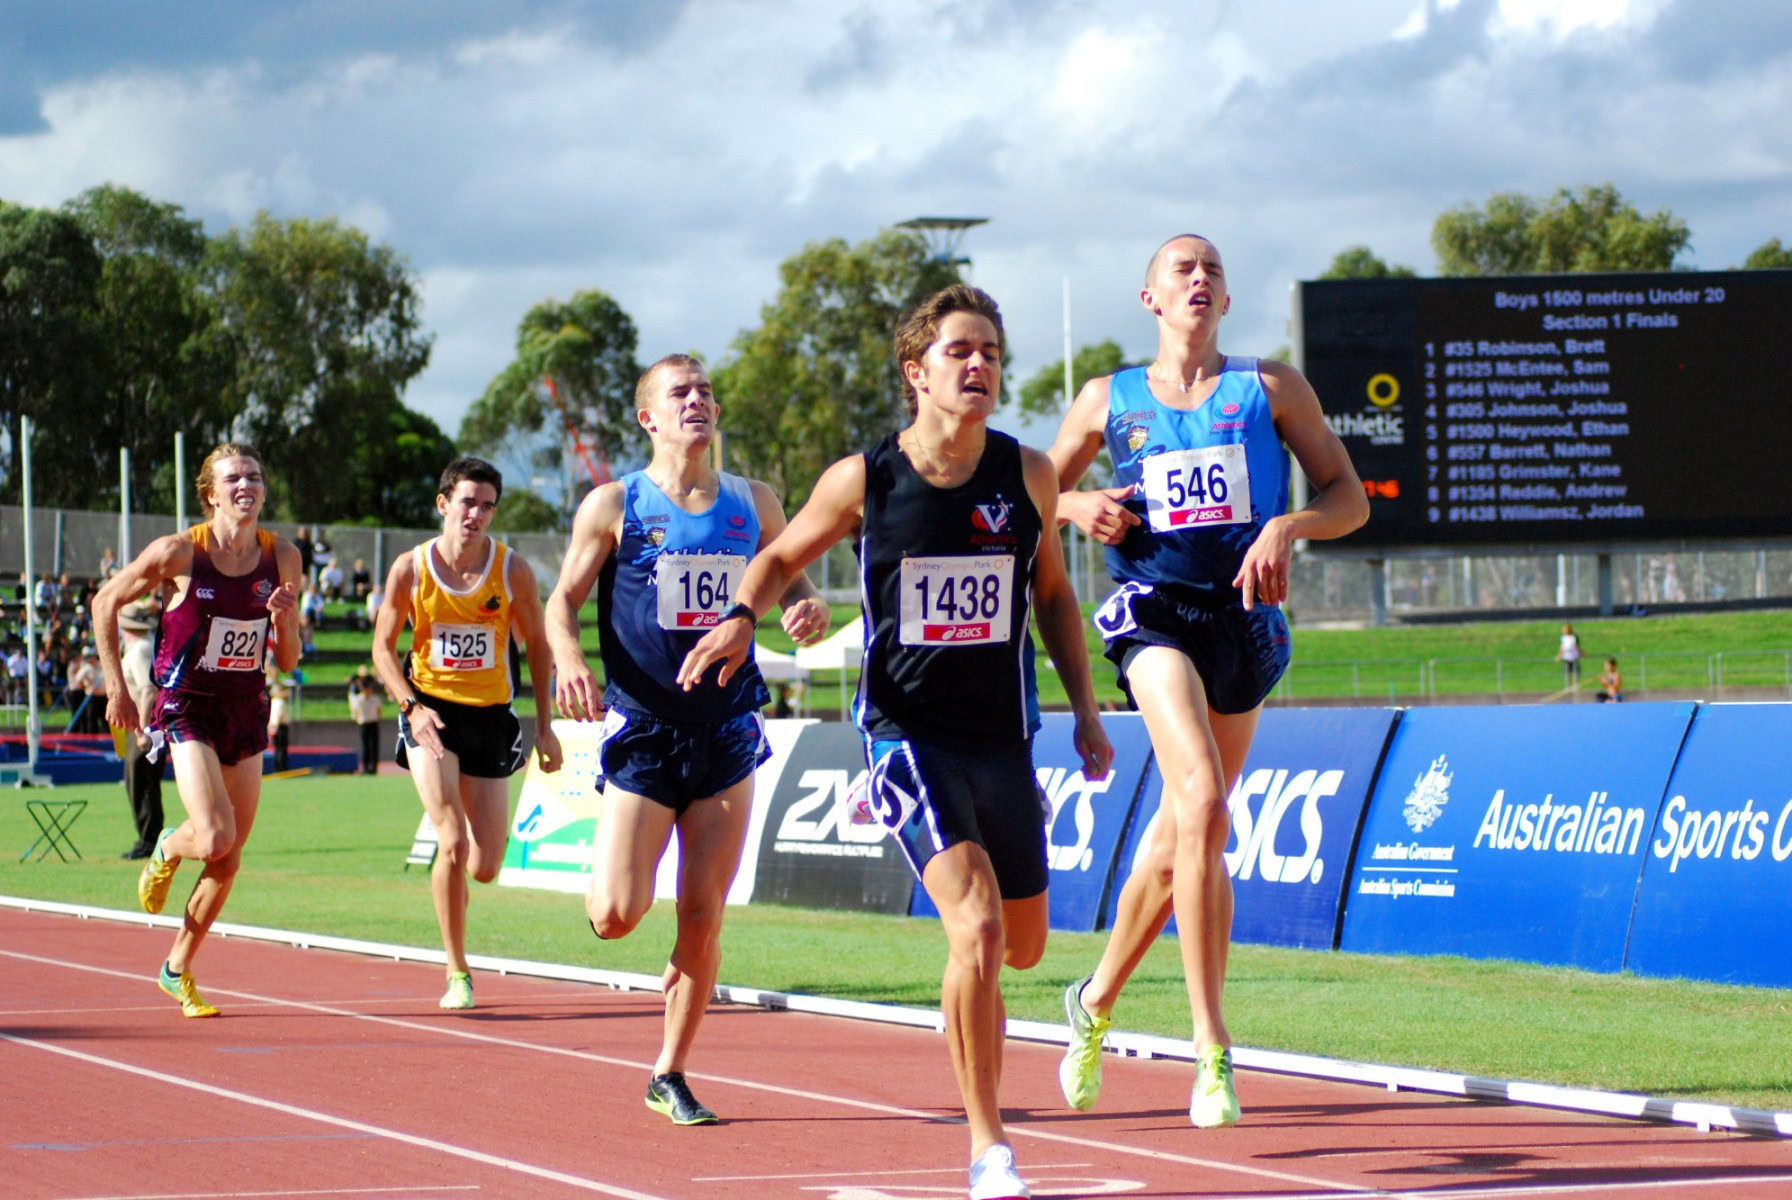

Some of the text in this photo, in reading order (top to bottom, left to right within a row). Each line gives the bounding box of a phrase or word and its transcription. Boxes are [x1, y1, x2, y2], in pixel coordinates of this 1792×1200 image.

[1495, 287, 1725, 311] Boys 1500 metres Under 20
[1543, 312, 1678, 330] Section 1 Finals
[1425, 342, 1435, 357] 1
[1477, 341, 1562, 356] Robinson,
[1565, 339, 1606, 354] Brett
[1425, 363, 1436, 378] 2
[1495, 361, 1569, 376] McEntee,
[1573, 360, 1609, 374] Sam
[1425, 383, 1436, 398] 3
[1487, 381, 1546, 399] Wright,
[1550, 380, 1609, 395] Joshua
[1425, 404, 1437, 418] 4
[1488, 402, 1564, 417] Johnson,
[1567, 401, 1628, 415] Joshua
[1426, 424, 1437, 440] 5
[1498, 422, 1578, 441] Heywood,
[1581, 421, 1629, 436] Ethan
[1427, 446, 1438, 461] 6
[1489, 444, 1550, 460] Barrett,
[1554, 443, 1611, 458] Nathan
[1428, 466, 1439, 481] 7
[1579, 463, 1621, 477] Kane
[1166, 463, 1228, 508] 546
[1427, 486, 1439, 501] 8
[1565, 483, 1627, 498] Andrew
[1428, 507, 1440, 522] 9
[1586, 503, 1644, 519] Jordan
[679, 571, 729, 610] 164
[915, 574, 1000, 621] 1438
[221, 630, 258, 657] 822
[439, 631, 487, 658] 1525
[1472, 788, 1645, 856] Australian
[1653, 795, 1770, 873] Sports
